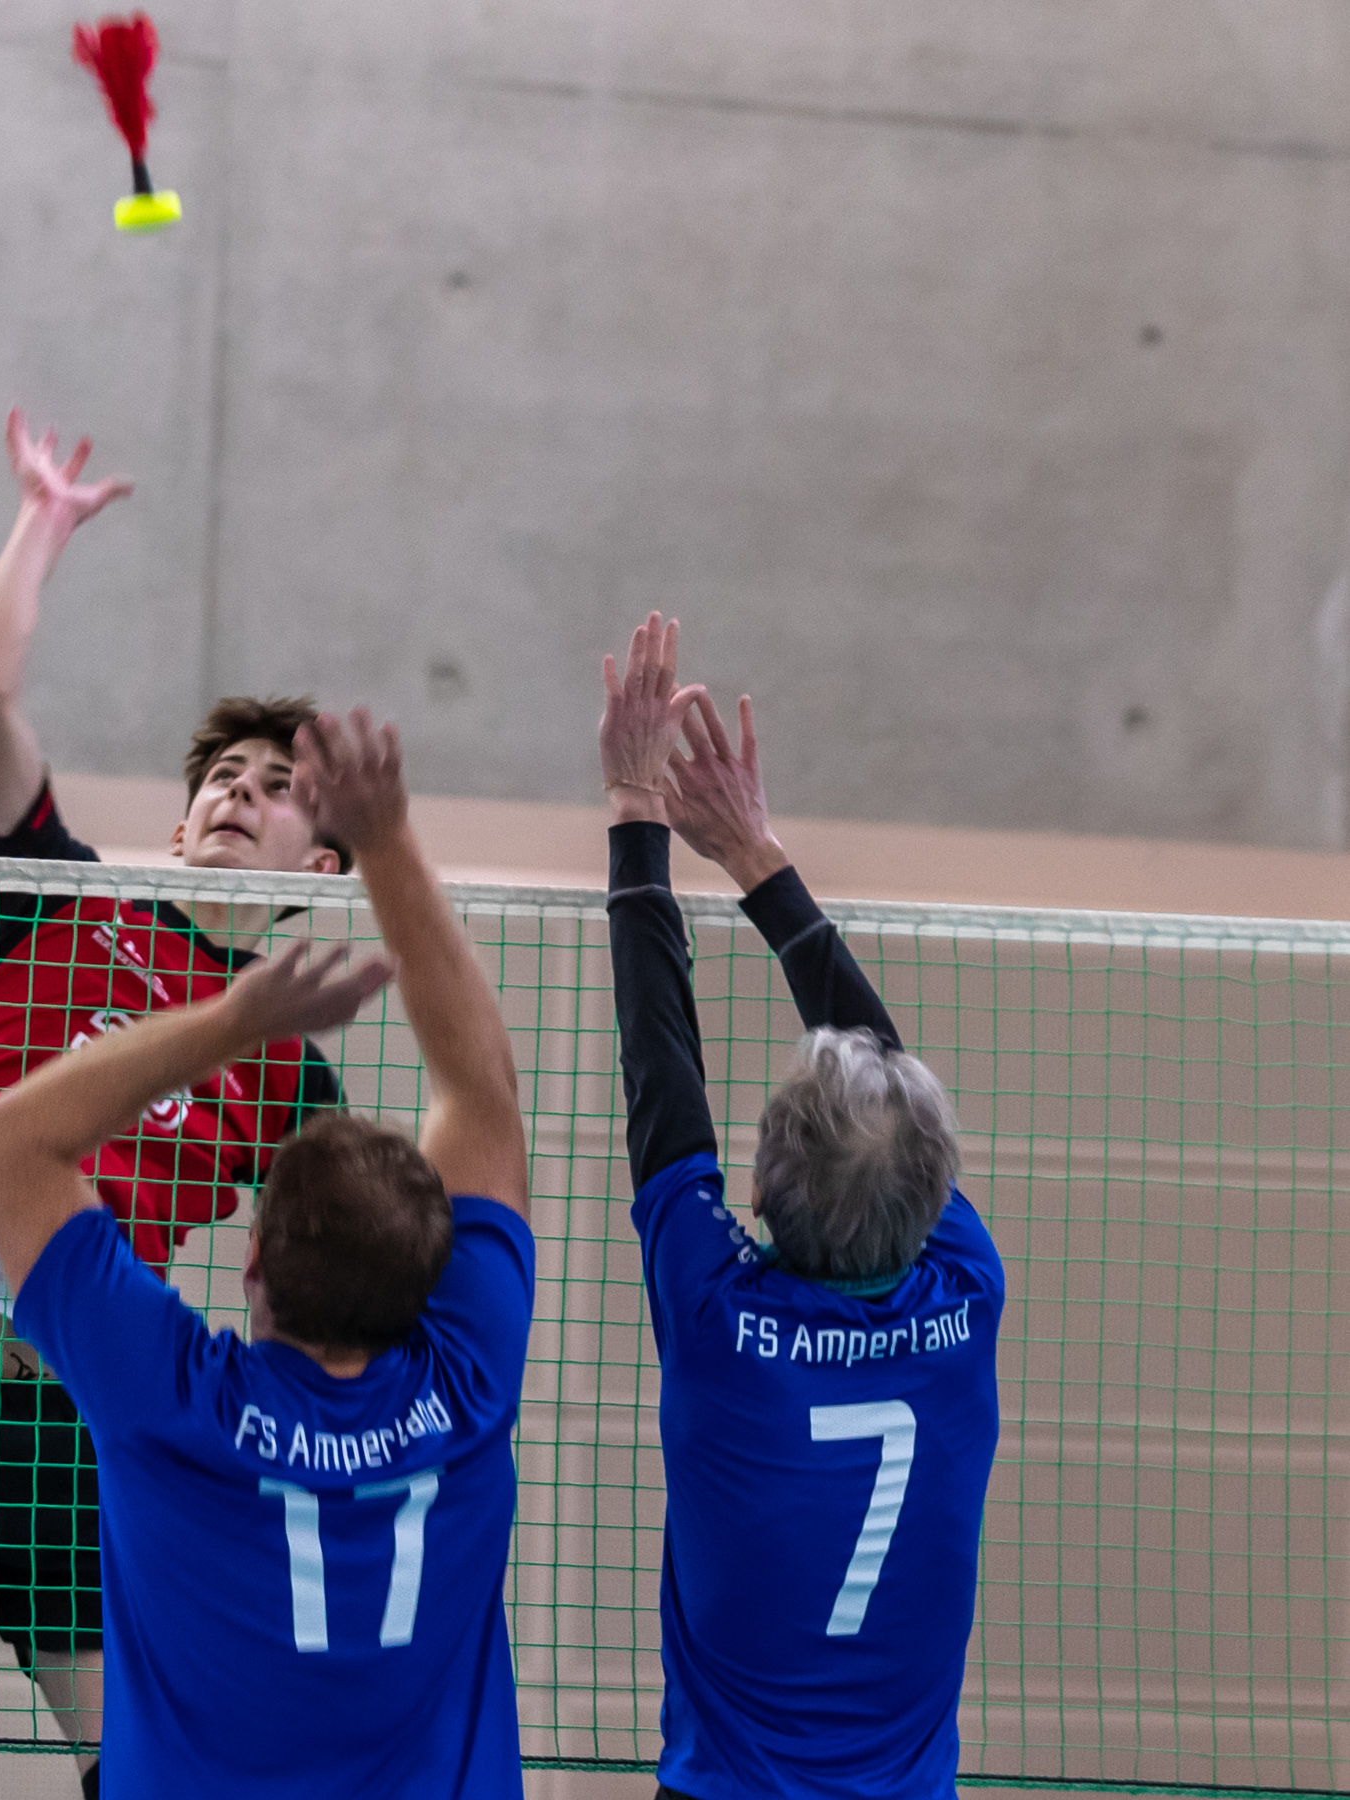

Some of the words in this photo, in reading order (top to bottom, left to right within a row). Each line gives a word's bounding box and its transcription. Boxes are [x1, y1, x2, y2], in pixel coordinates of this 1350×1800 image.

[736, 1311, 779, 1358] FS
[790, 1299, 970, 1367] Amperland
[235, 1404, 277, 1460] FS
[258, 1465, 446, 1653] 17
[809, 1400, 917, 1637] 7
